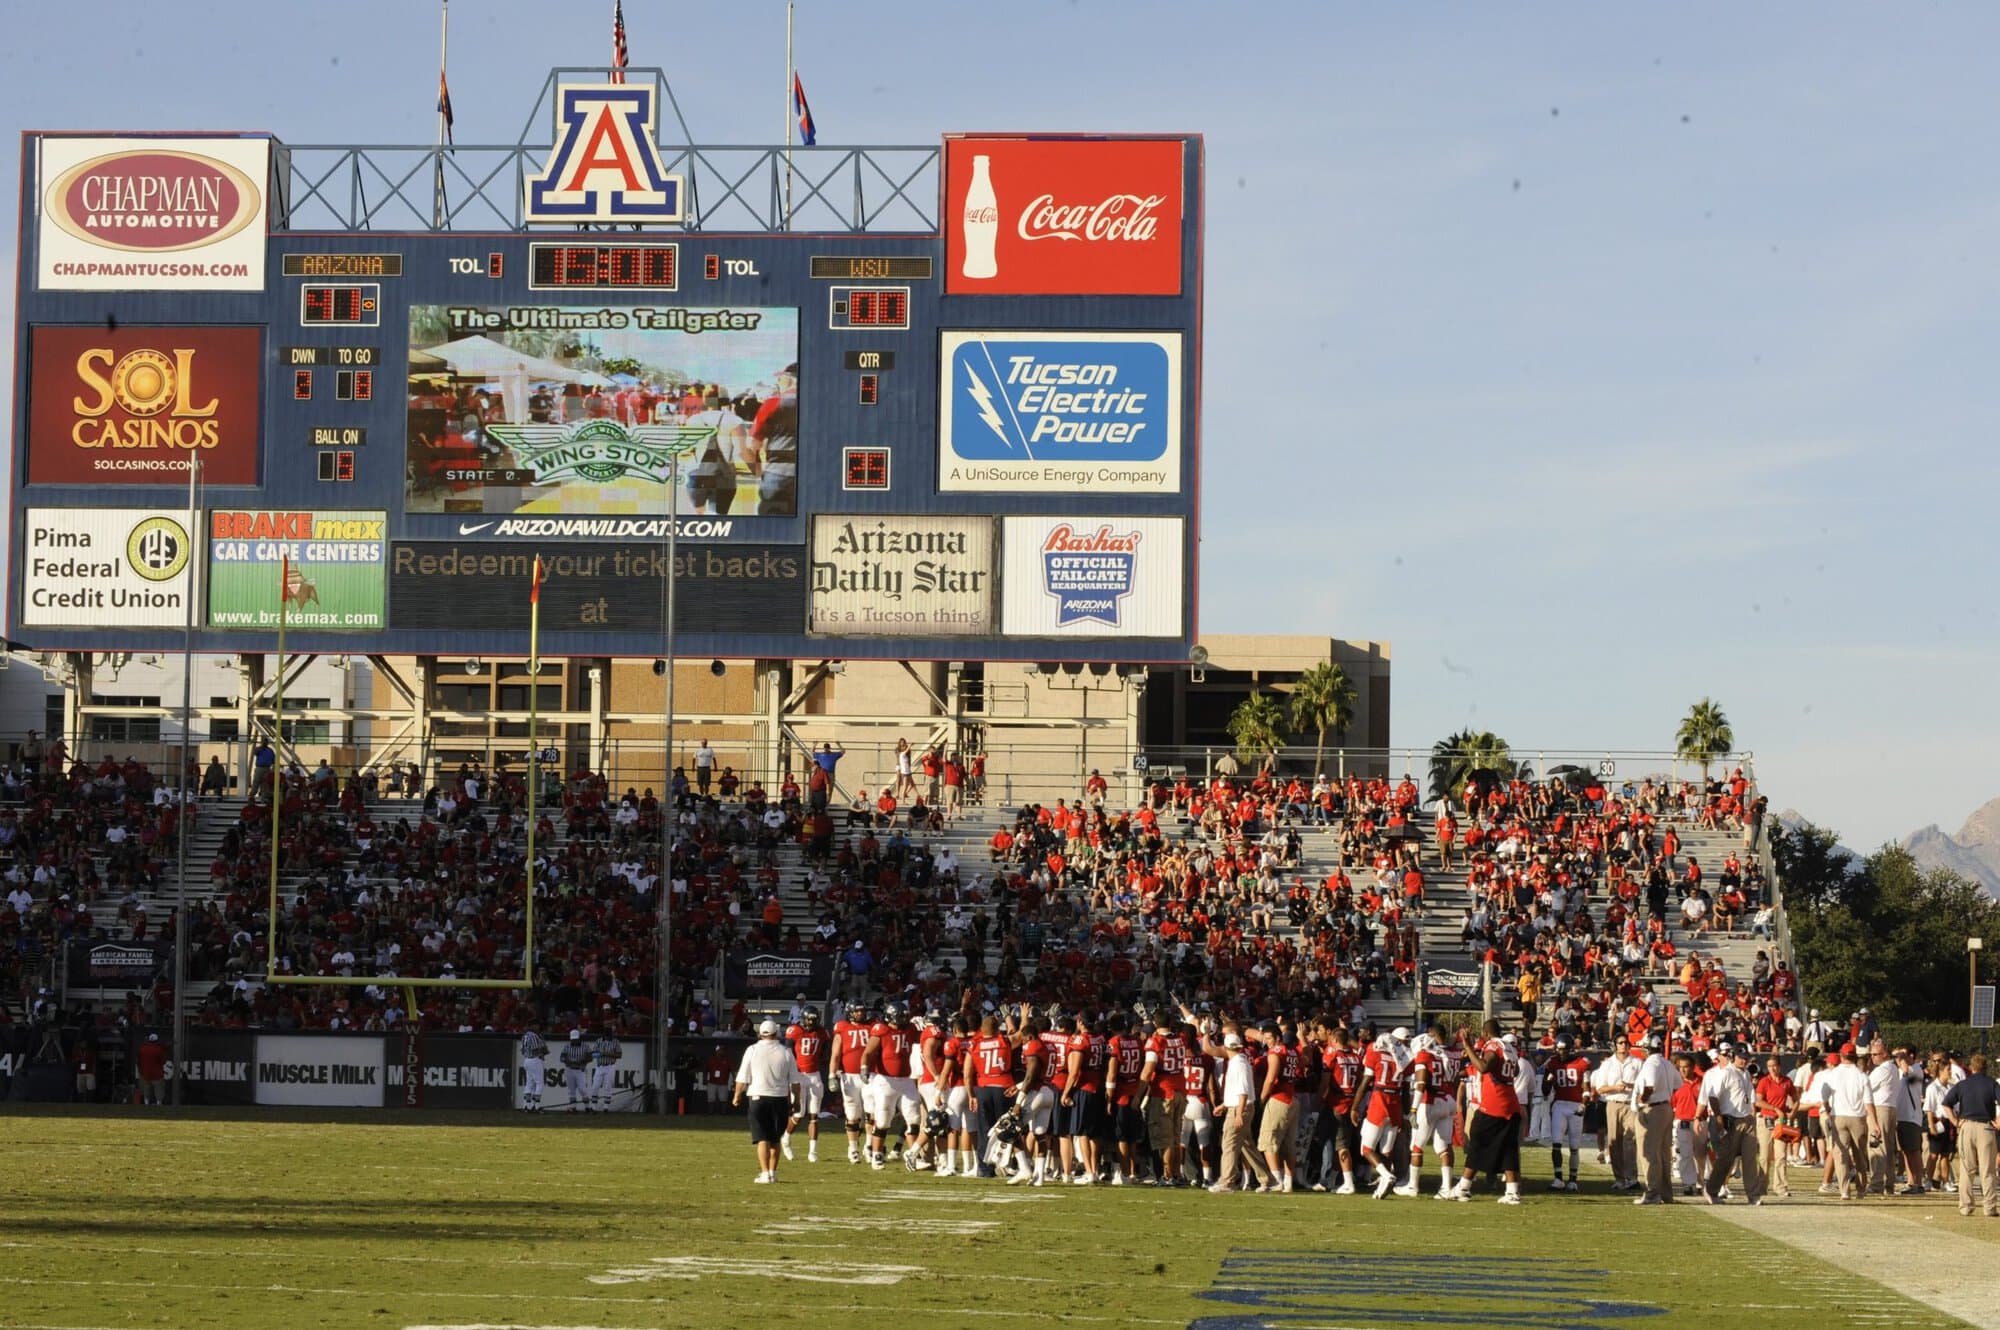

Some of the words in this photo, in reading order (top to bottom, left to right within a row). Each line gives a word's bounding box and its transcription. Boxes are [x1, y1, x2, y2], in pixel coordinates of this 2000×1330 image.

[525, 84, 685, 221] A
[82, 175, 222, 212] CHAPMAN
[85, 214, 219, 228] AUTOMOTIVE
[53, 262, 248, 277] CHAPMANTUCSON.COM
[303, 256, 384, 275] ARIZONA
[449, 258, 484, 274] TOL
[552, 248, 674, 284] 15:00
[724, 260, 759, 275] TOL
[850, 259, 890, 277] WSU
[306, 288, 360, 321] 41
[850, 292, 906, 325] 00
[450, 309, 499, 328] The
[510, 308, 628, 329] Ultimate
[635, 310, 759, 333] Tailgater
[291, 349, 316, 364] DWN
[338, 349, 352, 364] TO
[355, 349, 371, 364] GO
[858, 353, 881, 368] QTR
[1007, 356, 1118, 385] Tucson
[74, 348, 219, 417] SOL
[1017, 386, 1148, 414] Electric
[72, 419, 219, 449] CASINOS
[315, 430, 340, 444] BALL
[343, 430, 359, 444] ON
[1030, 415, 1146, 444] Power
[950, 469, 961, 480] A
[965, 468, 1039, 481] UniSource
[1044, 469, 1094, 484] Energy
[1098, 469, 1167, 484] Company
[212, 512, 313, 540] BRAKE
[313, 520, 384, 540] max
[495, 519, 733, 538] ARIZONAWILDCATS.COM
[34, 528, 92, 548] Pima
[832, 520, 967, 554] Arizona
[215, 542, 249, 561] CAR
[255, 542, 300, 561] CARE
[305, 543, 381, 561] CENTERS
[33, 558, 120, 578] Federal
[395, 546, 528, 577] Redeem
[540, 555, 605, 583] your
[613, 550, 696, 577] ticket
[704, 550, 799, 578] backs
[1051, 557, 1127, 568] OFFICIAL
[812, 560, 903, 601] Daily
[912, 560, 987, 594] Star
[1050, 570, 1127, 581] TAILGATE
[1051, 582, 1126, 591] HEADQUARTERS
[32, 588, 105, 609] Credit
[111, 589, 181, 609] Union
[1064, 600, 1114, 609] ARIZONA
[581, 597, 608, 623] at
[812, 606, 840, 623] It's
[846, 611, 856, 623] a
[862, 606, 925, 623] Tucson
[1135, 756, 1147, 769] 29
[1601, 762, 1614, 775] 30
[801, 1037, 819, 1056] 87
[205, 1061, 247, 1081] MILK
[405, 1025, 420, 1105] WILDCATS
[980, 1048, 1006, 1075] 74
[1120, 1049, 1140, 1074] 32
[260, 1064, 328, 1084] MUSCLE
[332, 1065, 376, 1084] MILK
[461, 1066, 505, 1088] MILK
[1556, 1068, 1578, 1087] 89
